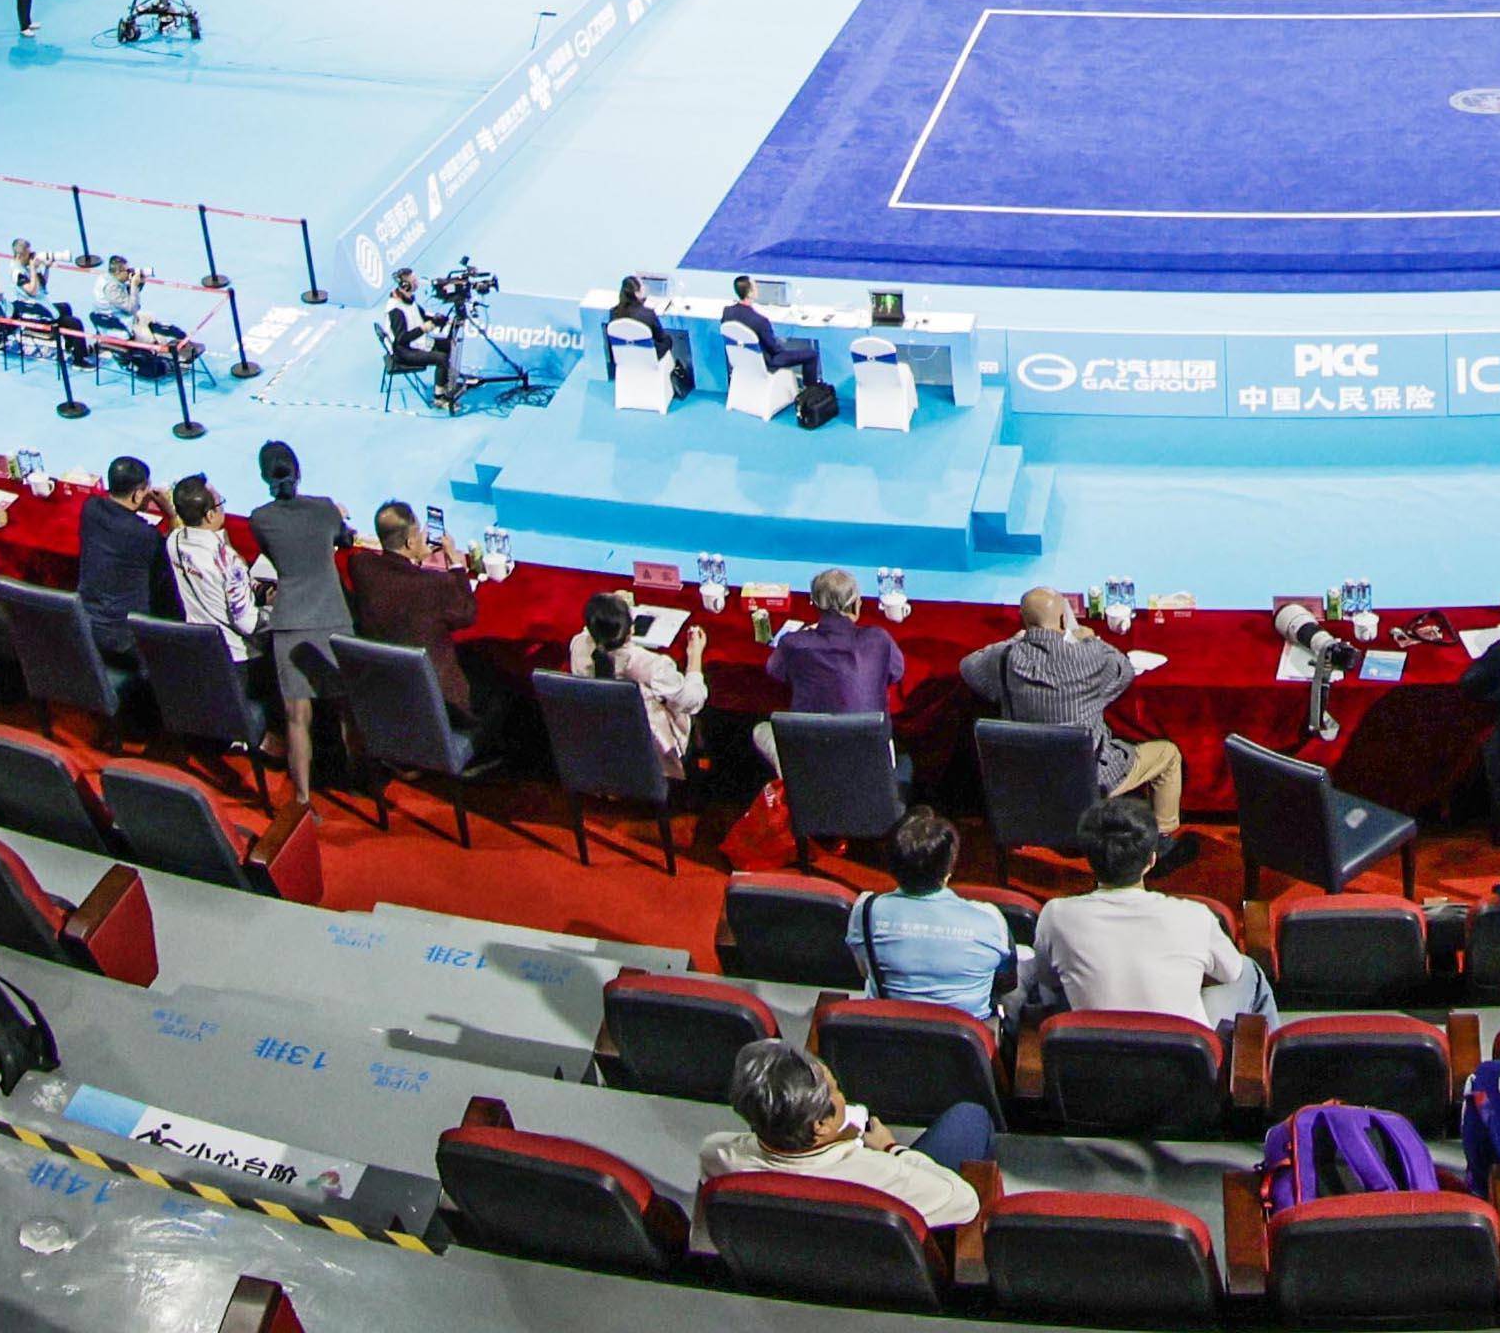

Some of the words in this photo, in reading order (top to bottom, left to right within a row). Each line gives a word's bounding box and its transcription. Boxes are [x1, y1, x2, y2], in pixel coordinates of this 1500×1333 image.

[465, 319, 585, 350] Guangzhou
[1082, 359, 1217, 379] 广汽集团
[1294, 343, 1379, 377] PICC
[1082, 378, 1130, 392] GAC
[1133, 378, 1217, 393] GROUP
[1238, 386, 1436, 412] 中国人民保险
[253, 1037, 328, 1070] 13排
[185, 1143, 298, 1185] 小心台阶
